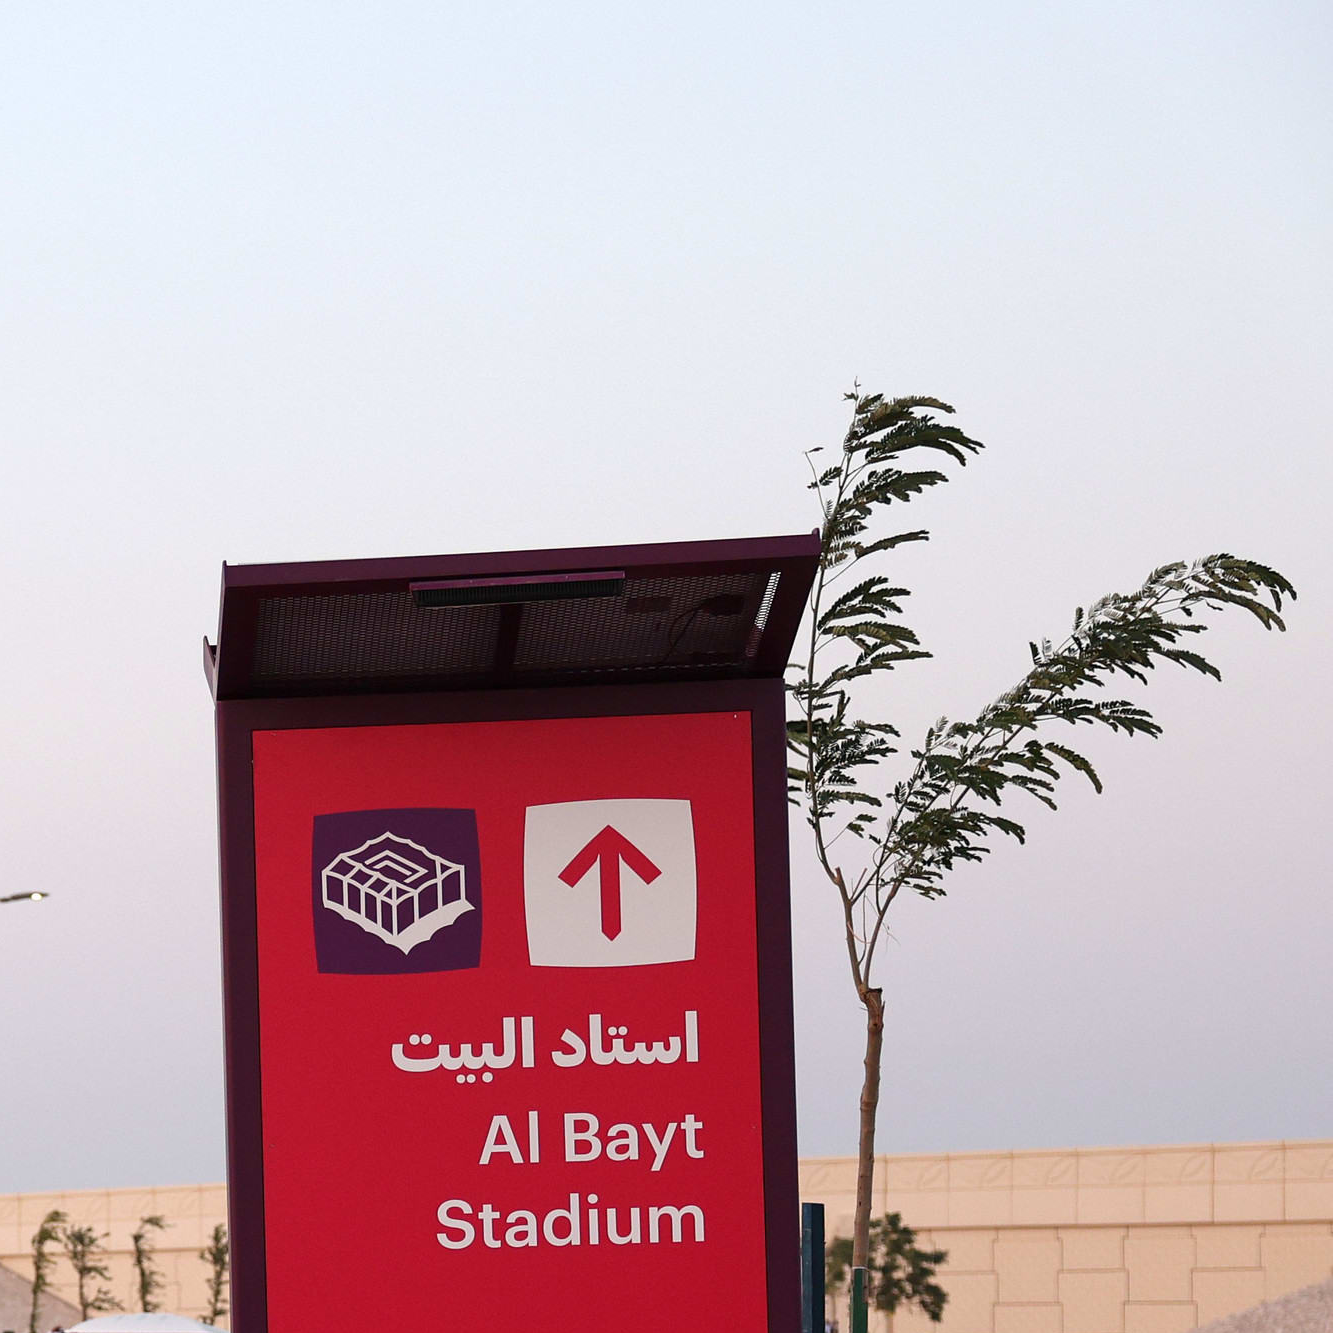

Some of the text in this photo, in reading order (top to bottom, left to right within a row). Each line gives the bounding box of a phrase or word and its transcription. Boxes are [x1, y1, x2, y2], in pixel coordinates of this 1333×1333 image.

[391, 1010, 699, 1084] استاد البيت
[479, 1110, 704, 1172] Al Bayt
[436, 1192, 705, 1250] Stadium
